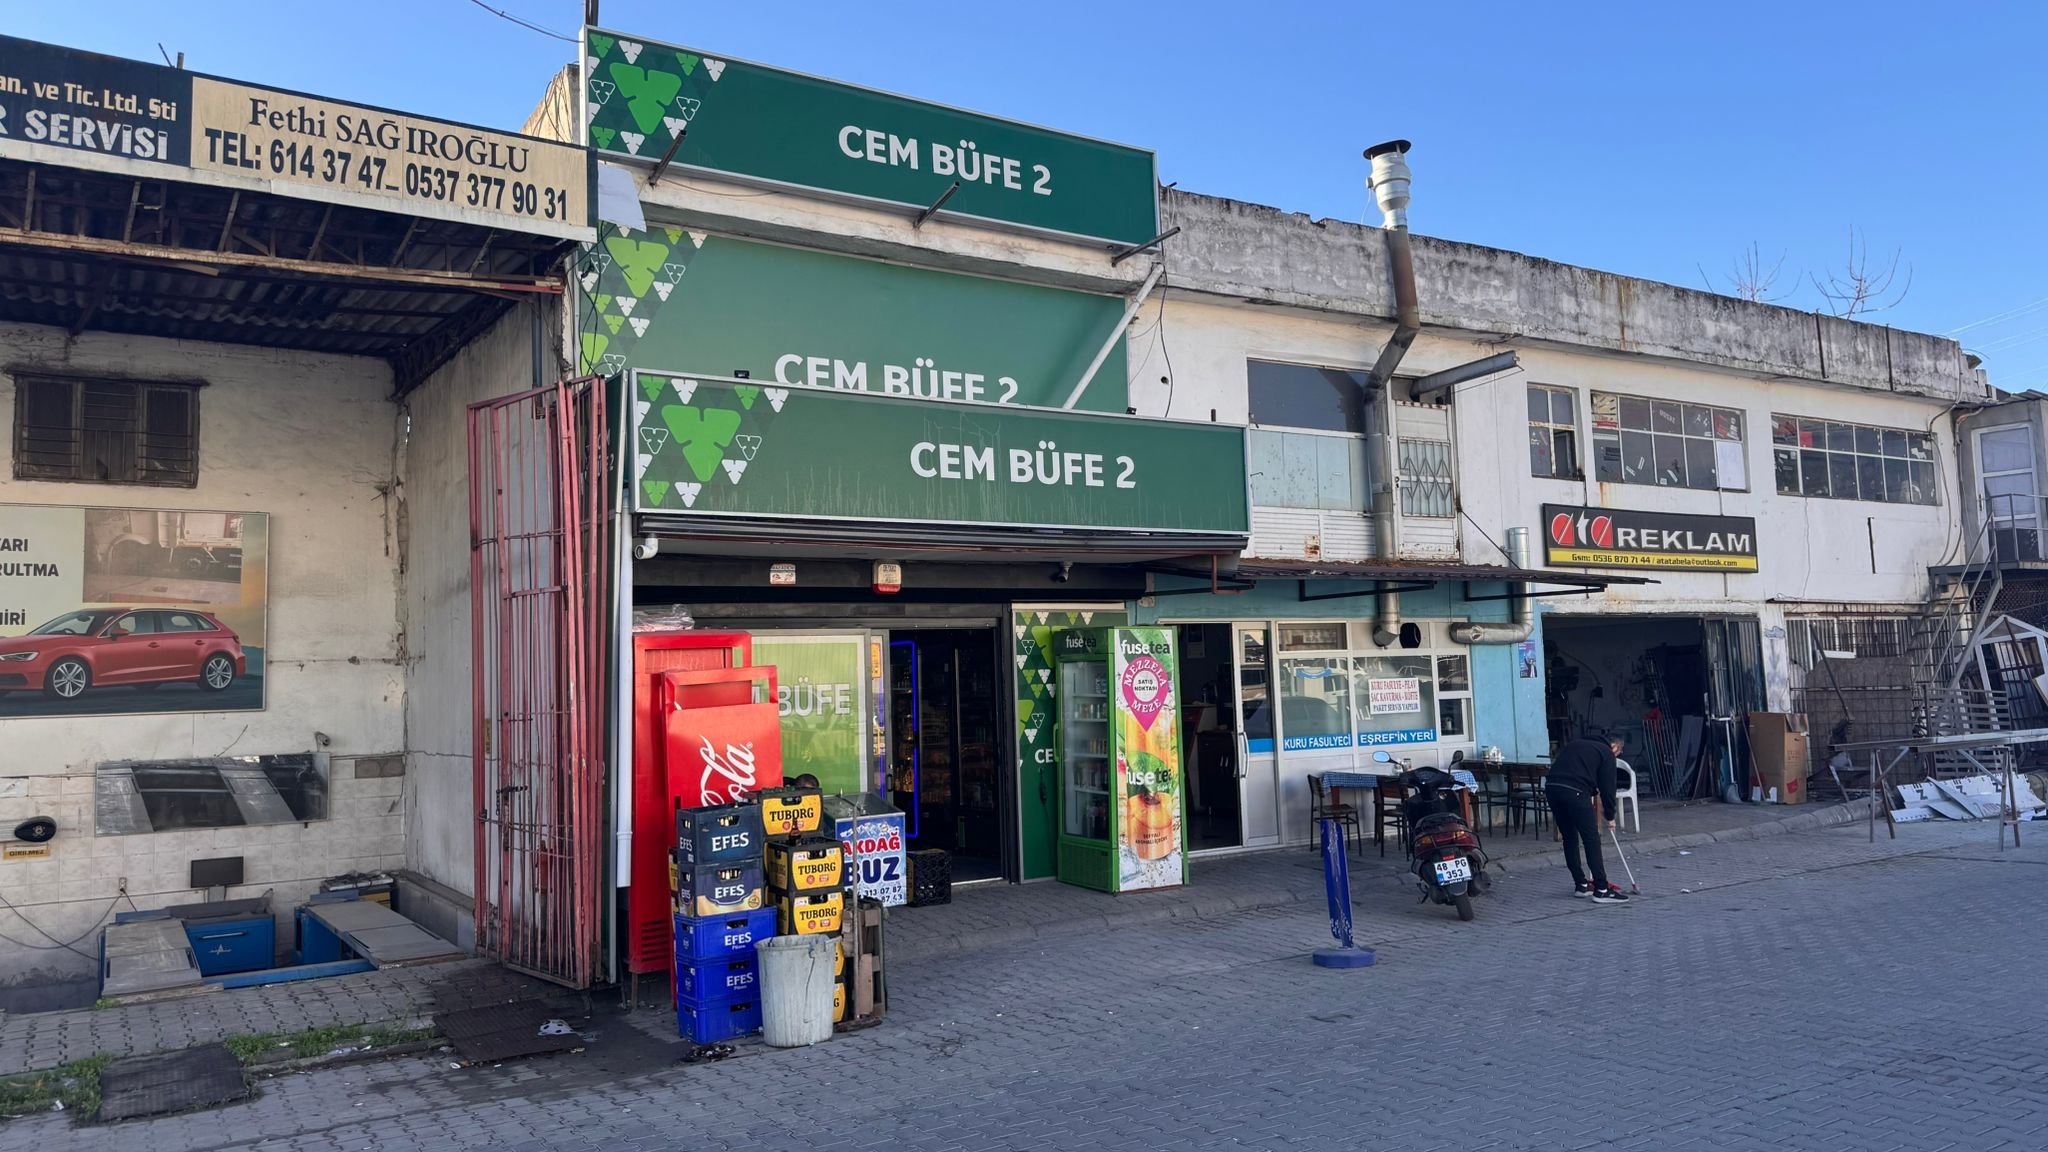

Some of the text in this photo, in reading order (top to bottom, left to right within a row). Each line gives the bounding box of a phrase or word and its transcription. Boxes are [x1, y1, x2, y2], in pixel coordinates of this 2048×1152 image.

[33, 82, 59, 100] ve
[64, 83, 100, 107] Tic.
[104, 89, 143, 115] Ltd.
[249, 97, 327, 138] Fethi
[24, 109, 169, 160] SERVİSİ
[838, 125, 1053, 196] CEM BÜFE 2
[205, 127, 261, 170] TEL:
[270, 139, 315, 178] 614
[322, 148, 352, 184] 37
[406, 163, 459, 202] 0537
[467, 173, 505, 210] 377
[512, 181, 538, 216] 90
[544, 187, 567, 221] 31
[910, 440, 1137, 489] CEM BÜFE 2
[0, 537, 29, 552] ARI
[1617, 527, 1751, 552] REKLAM
[1593, 554, 1613, 563] 0536
[1614, 555, 1629, 563] 870
[1631, 556, 1638, 564] 71
[1640, 556, 1651, 564] 44
[0, 562, 59, 577] ULTMA
[0, 608, 26, 626] İRİ
[1124, 659, 1167, 687] MEZZELA
[778, 676, 851, 717] BÜFE
[1131, 699, 1162, 713] MEZE
[1284, 734, 1352, 749] KURU FASULYECİ
[1410, 729, 1434, 742] YERİ
[1034, 748, 1054, 764] CE
[769, 807, 815, 822] TUBORG
[680, 836, 693, 852] EFES
[712, 832, 750, 852] EFES
[798, 862, 836, 876] TUBORG
[843, 856, 900, 886] BUZ
[1437, 859, 1467, 871] 48 PG
[1446, 869, 1464, 879] 353
[715, 884, 745, 900] EFES
[800, 907, 837, 921] TUBORG
[724, 932, 752, 946] EFES
[726, 972, 754, 987] EFES
